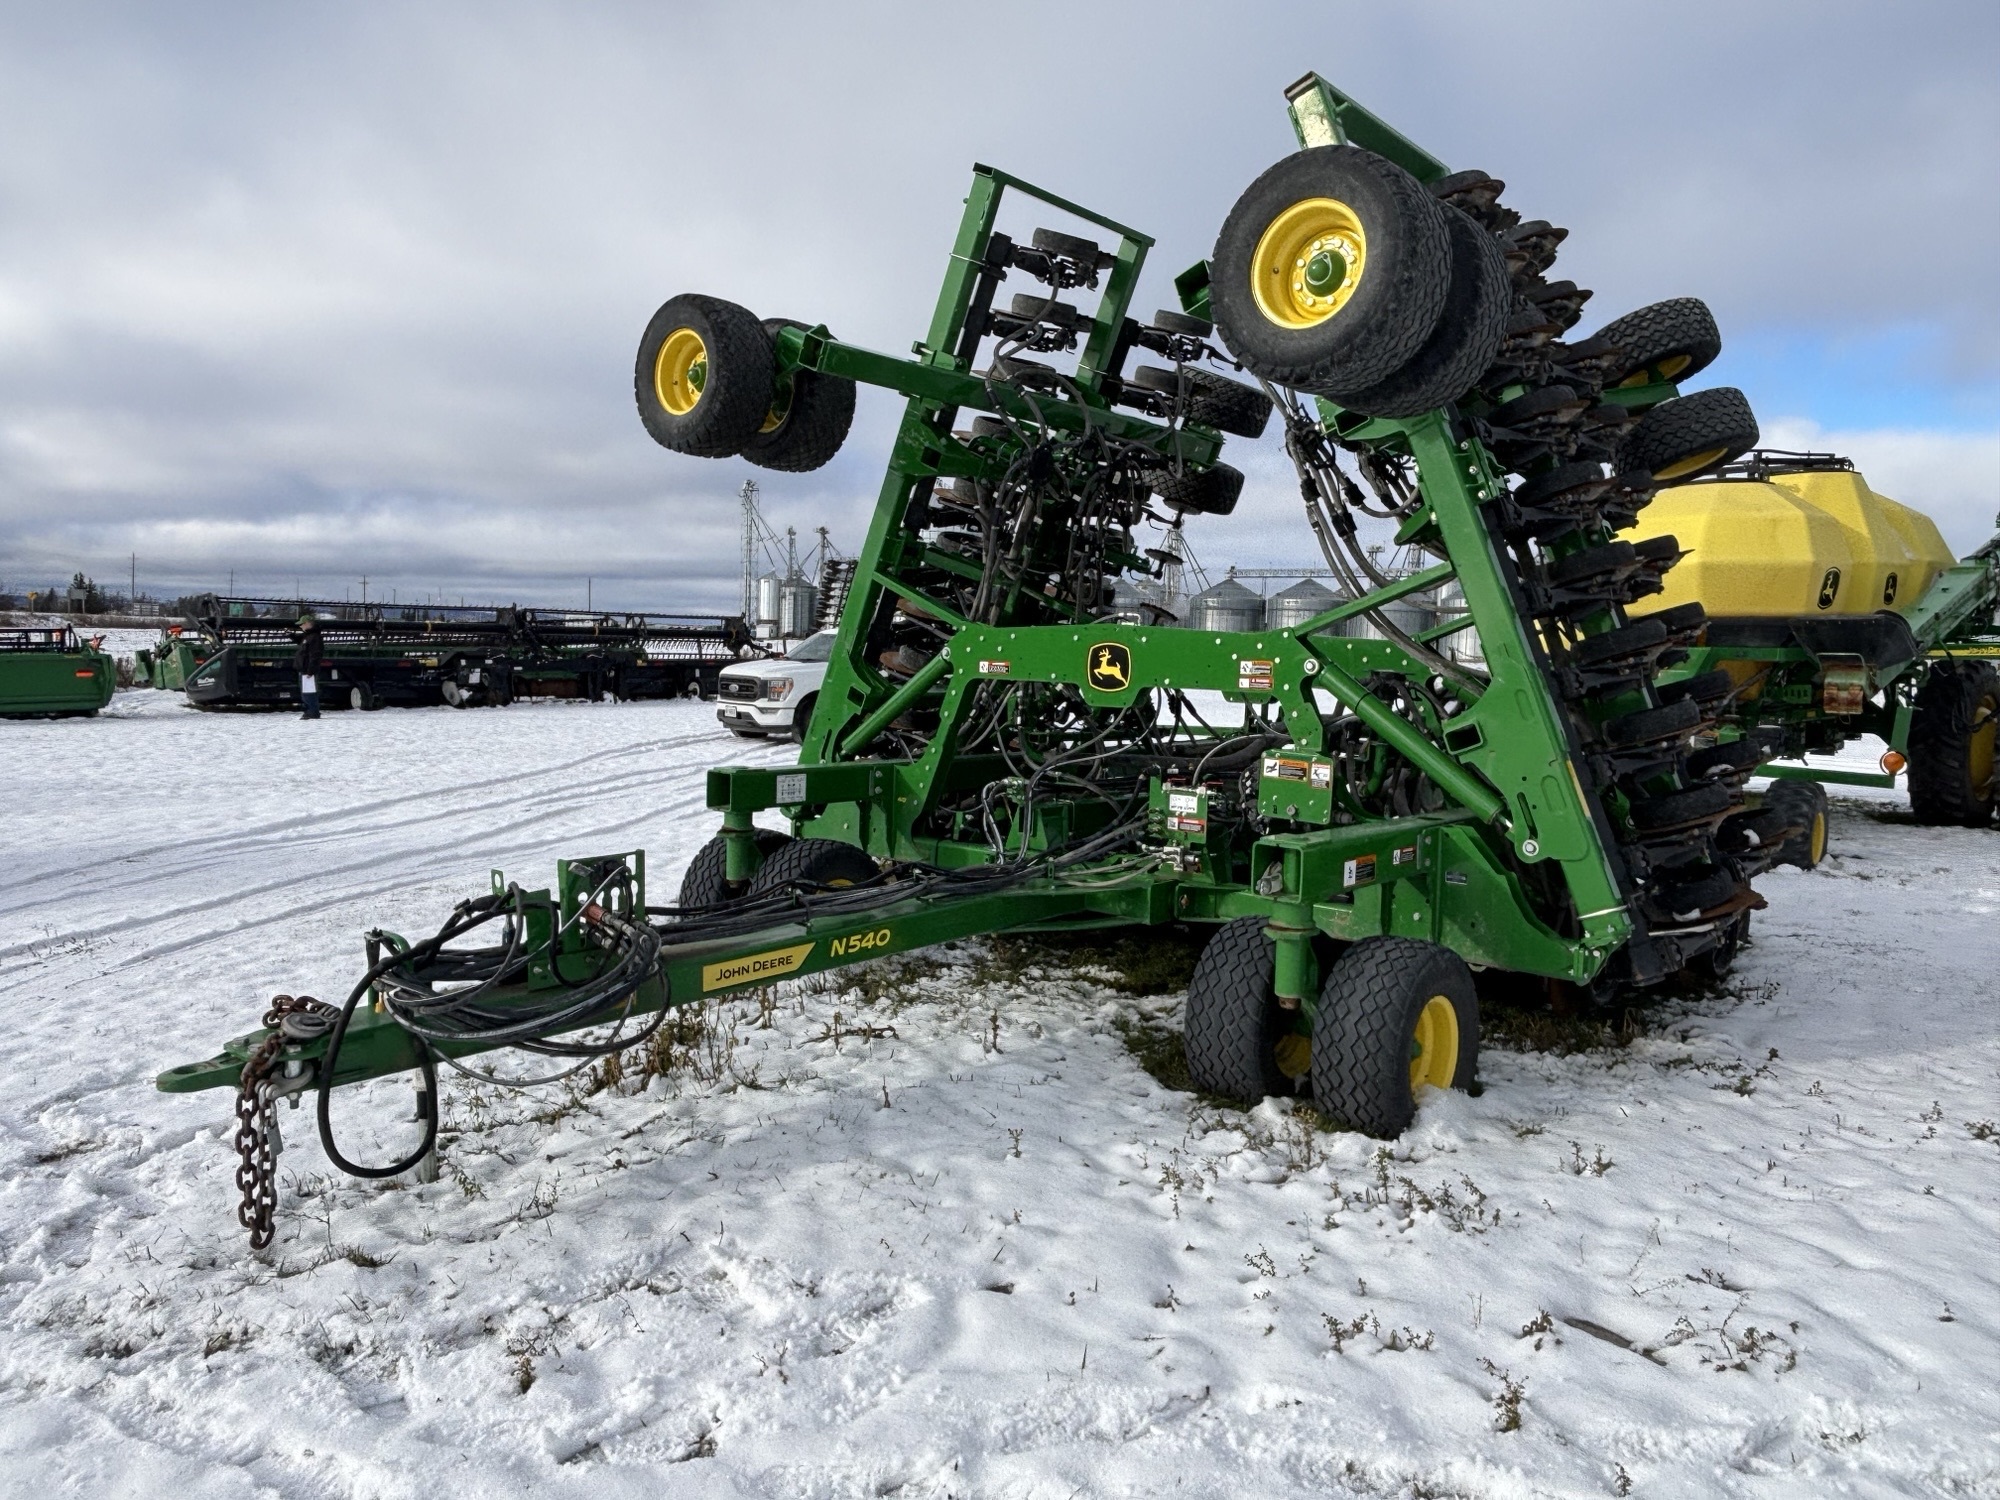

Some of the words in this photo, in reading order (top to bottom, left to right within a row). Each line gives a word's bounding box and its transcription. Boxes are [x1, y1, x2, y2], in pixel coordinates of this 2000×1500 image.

[830, 929, 891, 957] N540
[715, 965, 750, 981] JOHN
[753, 955, 794, 973] DEERE
